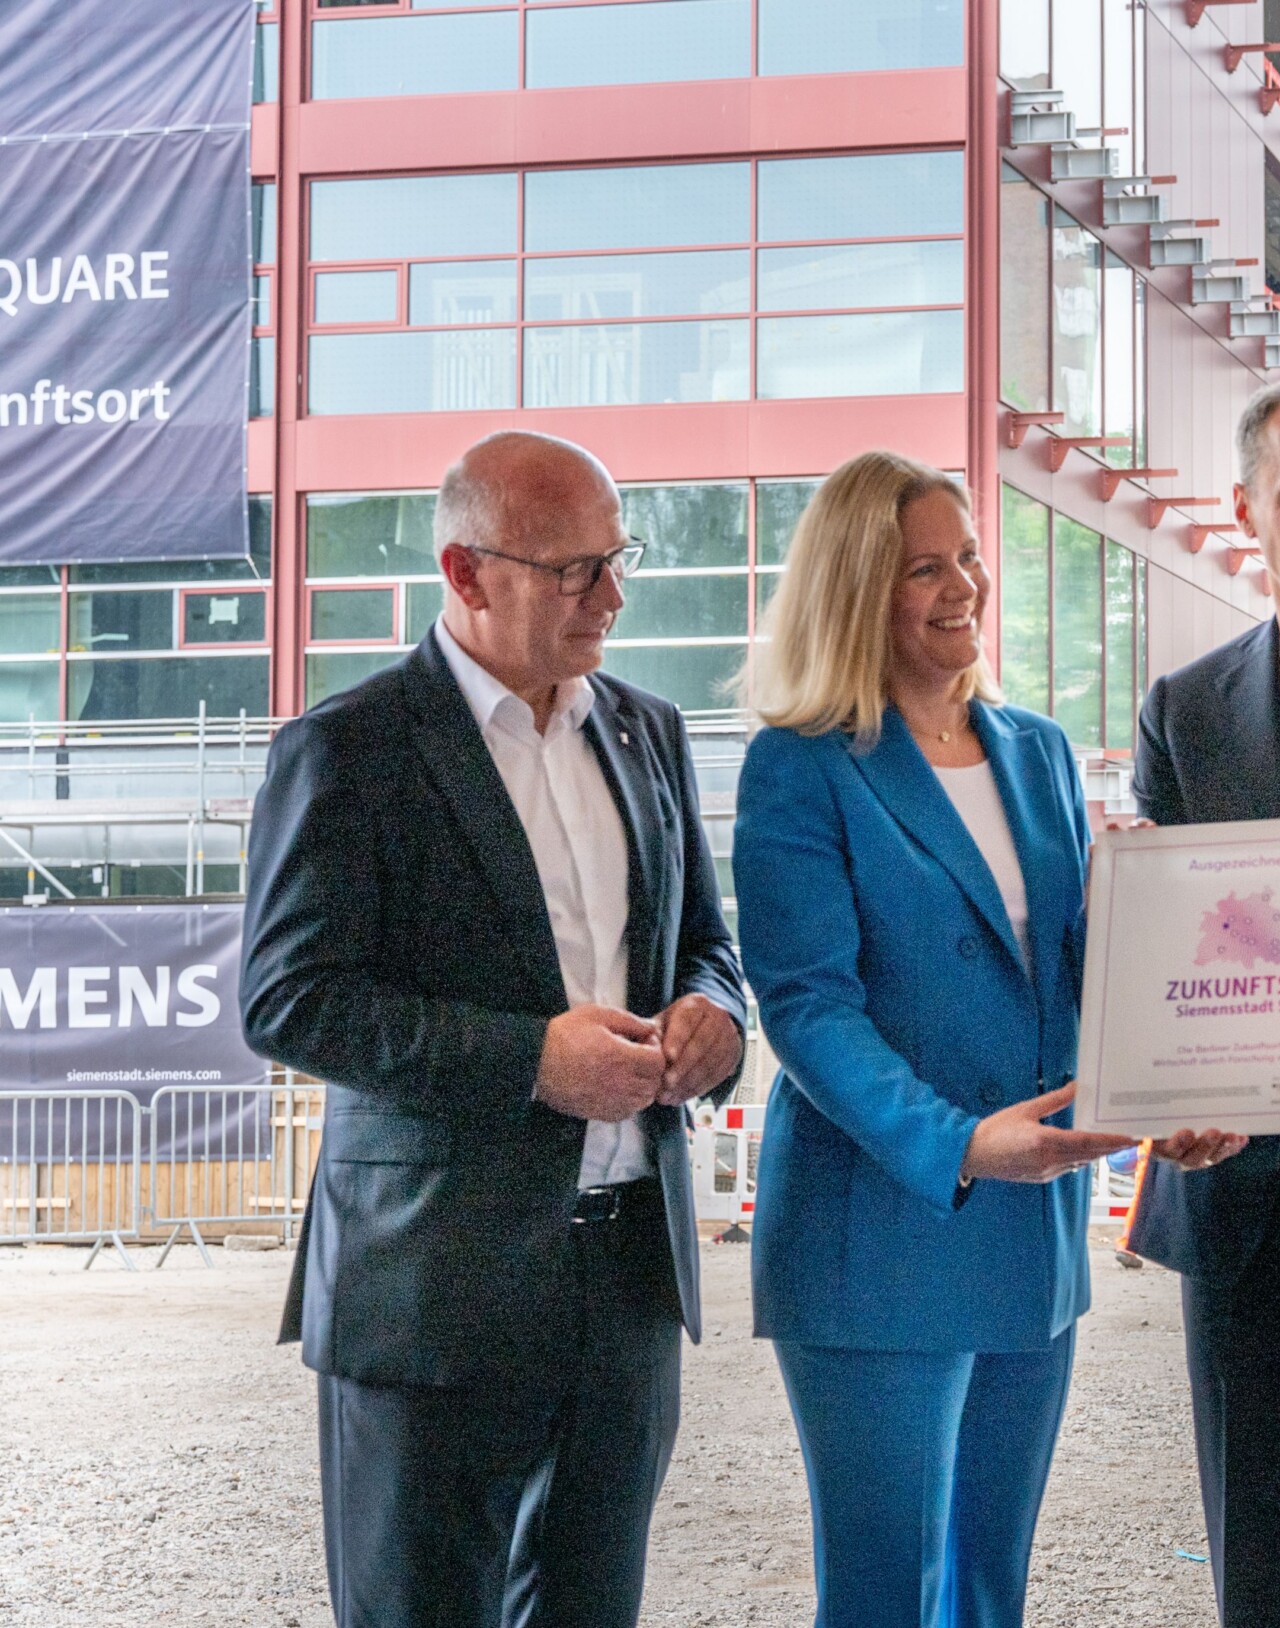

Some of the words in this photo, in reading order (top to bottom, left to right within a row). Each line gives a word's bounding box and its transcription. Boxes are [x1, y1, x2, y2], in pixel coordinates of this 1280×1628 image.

[0, 379, 170, 427] nftsort
[0, 964, 221, 1029] MENS
[1175, 1001, 1274, 1018] Siemensstadt
[66, 1068, 222, 1082] siemensstadt.siemens.com
